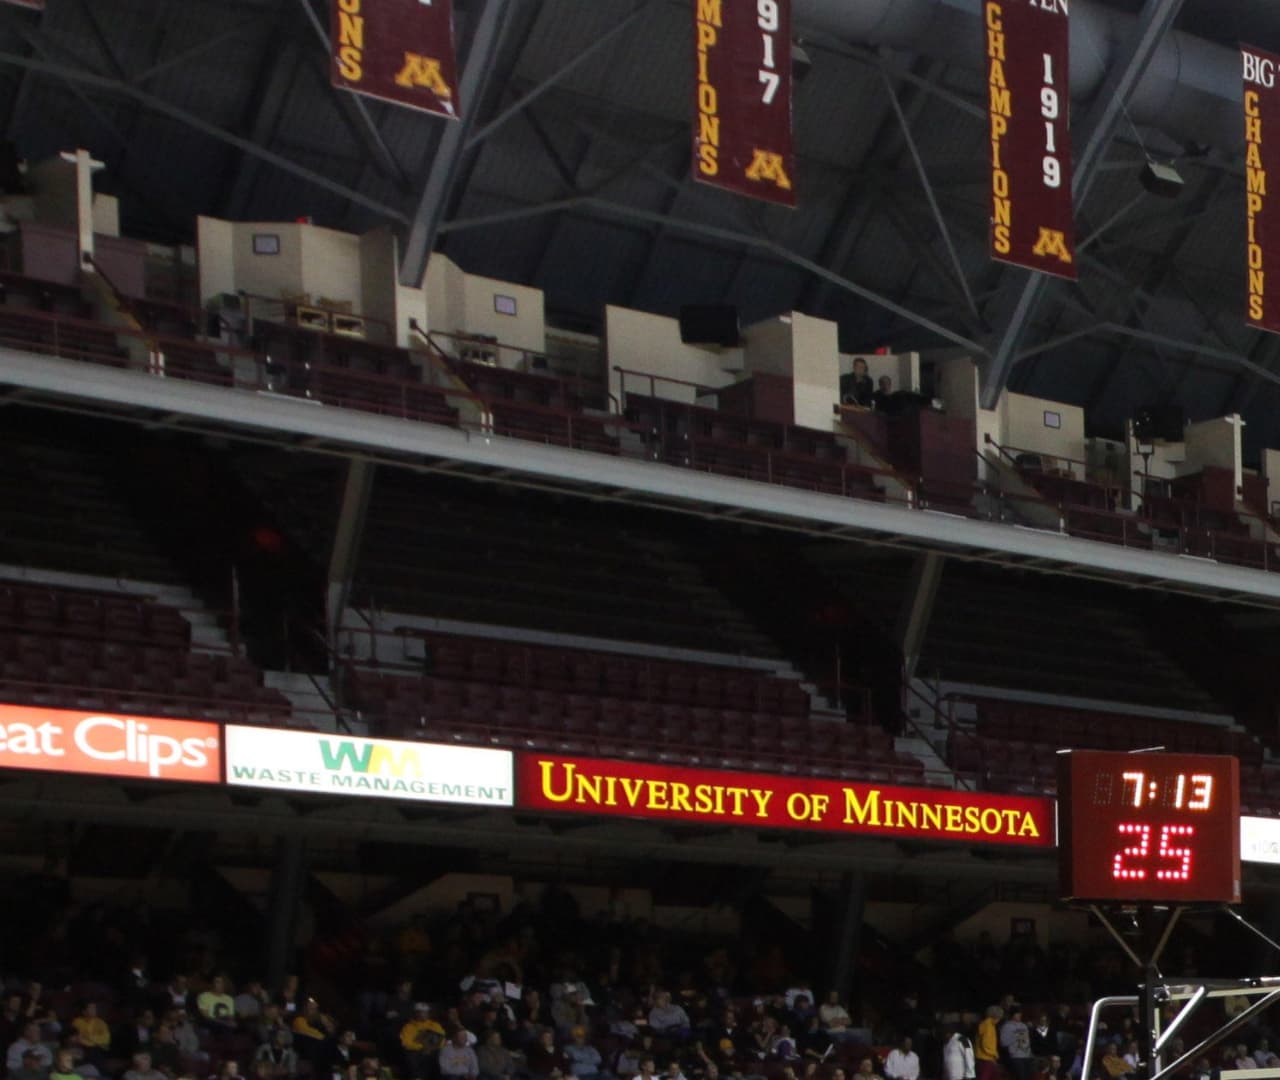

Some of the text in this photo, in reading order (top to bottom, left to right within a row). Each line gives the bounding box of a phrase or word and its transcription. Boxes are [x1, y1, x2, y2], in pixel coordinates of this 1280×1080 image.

[1242, 51, 1275, 88] BIG
[985, 3, 1012, 254] CHAMPIONS
[1041, 54, 1061, 188] 1919
[1244, 90, 1266, 321] CHAMPIONS
[73, 716, 209, 777] Clips
[233, 765, 507, 801] WASTE MANAGEMENT
[538, 760, 1039, 838] UNIVERSITY OF MINNESOTA
[1122, 772, 1214, 810] 7:13
[1112, 823, 1194, 879] 25
